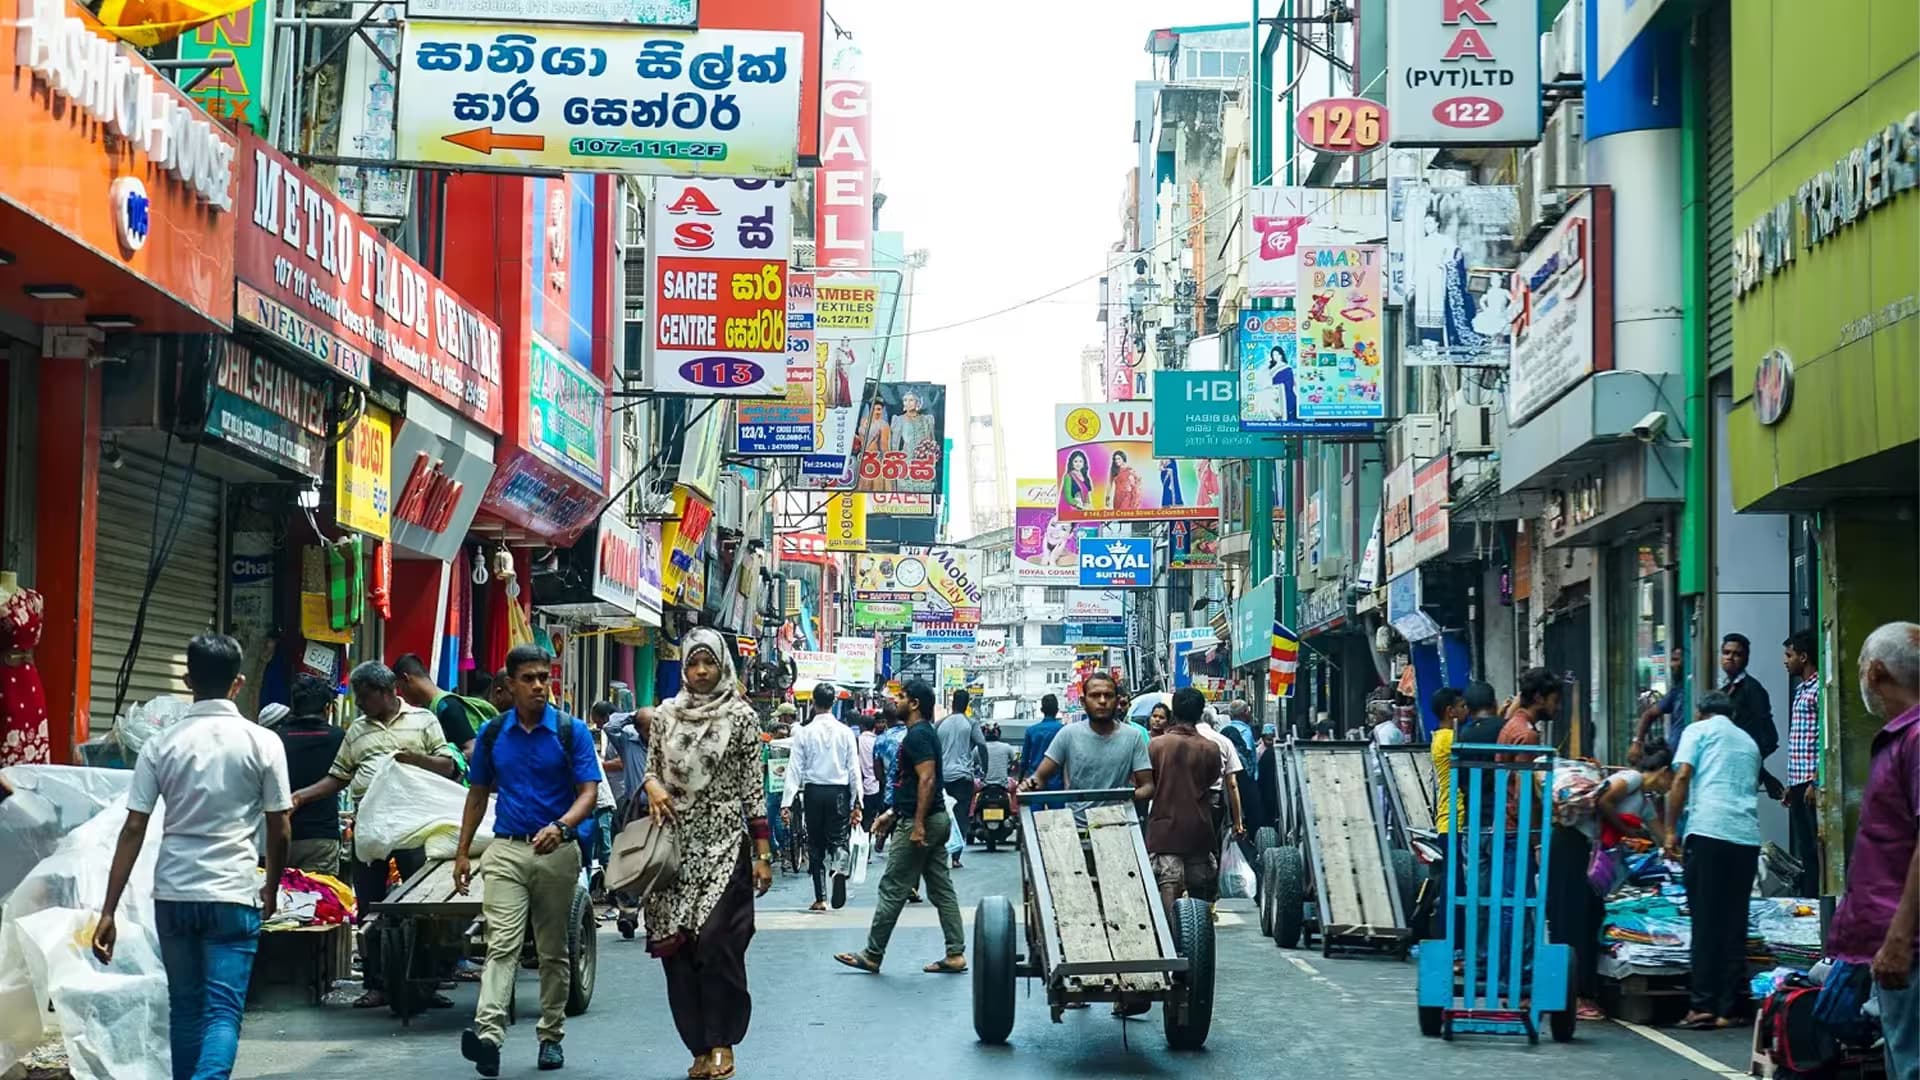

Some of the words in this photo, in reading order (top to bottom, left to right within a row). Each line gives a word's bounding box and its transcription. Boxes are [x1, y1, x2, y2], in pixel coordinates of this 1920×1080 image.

[416, 34, 608, 77] සානියා
[636, 39, 787, 90] සිල්ක්
[1405, 68, 1514, 88] (PVT)LTD
[453, 79, 540, 123] සාරි
[563, 92, 742, 131] සෙන්ටර්
[1444, 102, 1491, 122] 122
[1308, 106, 1381, 146] 126
[572, 139, 722, 156] 107-111-2F
[665, 174, 723, 251] AS
[254, 149, 353, 285] METRO
[359, 230, 429, 339] TRADE
[434, 287, 500, 386] CENTRE
[1303, 248, 1376, 268] SMART
[663, 269, 719, 301] SAREE
[731, 263, 782, 302] සාරි
[1312, 270, 1366, 289] BABY
[816, 287, 875, 302] AMBER
[816, 302, 874, 314] TEXTILES
[308, 277, 341, 321] Second
[341, 303, 365, 336] Cross
[391, 333, 420, 373] Colombo
[660, 315, 717, 347] CENTRE
[724, 308, 786, 351] සෙන්ටර්
[689, 363, 755, 384] 113
[1186, 380, 1239, 401] HB
[1109, 411, 1152, 436] VIJ
[1186, 414, 1220, 422] HABIB
[1223, 414, 1240, 422] BA
[231, 560, 275, 576] Chat
[1081, 553, 1150, 571] ROYAL
[932, 549, 982, 604] Mobile
[1095, 571, 1136, 579] SUITING
[926, 629, 974, 637] BROTHERS
